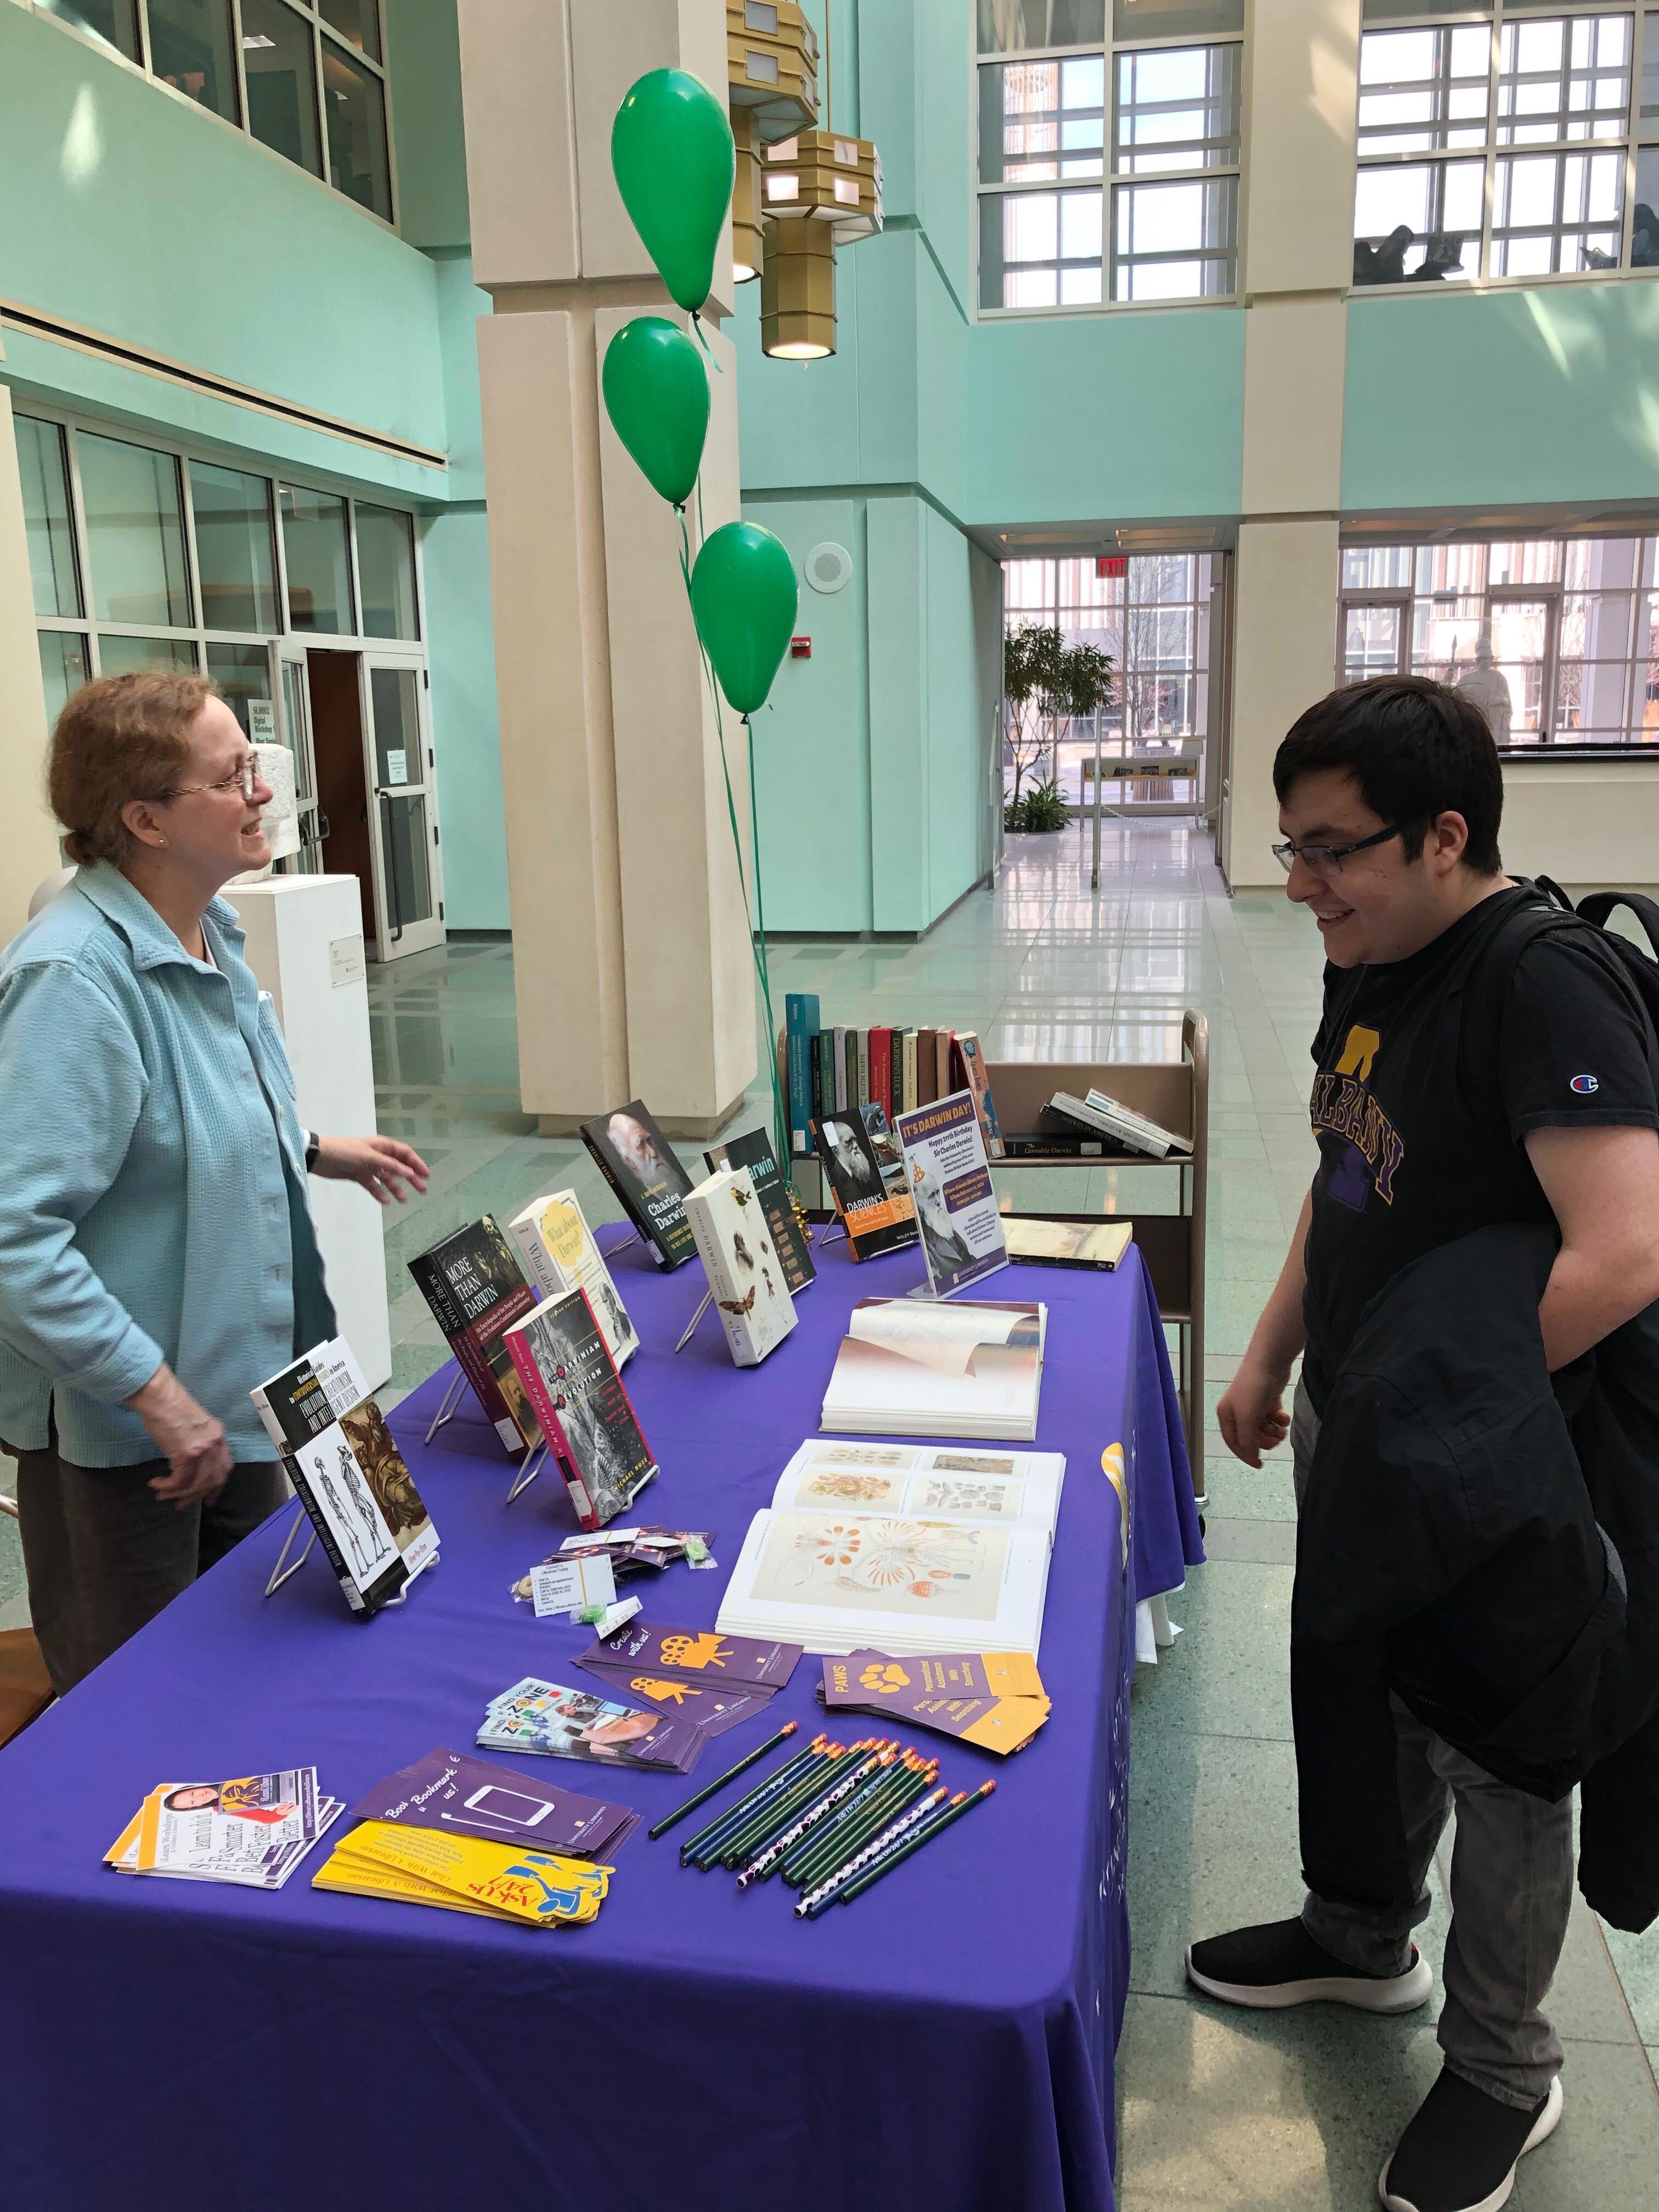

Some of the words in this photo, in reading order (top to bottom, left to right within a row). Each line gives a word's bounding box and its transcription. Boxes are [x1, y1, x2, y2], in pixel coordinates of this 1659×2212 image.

[1100, 558, 1126, 576] EXIT
[902, 1122, 918, 1139] IT'S
[918, 1108, 953, 1132] DARWIN
[952, 1102, 972, 1120] DAY!
[928, 1137, 943, 1148] Happy
[954, 1125, 973, 1137] Birthday
[940, 1143, 956, 1154] Charles
[956, 1136, 973, 1149] Darwin!
[749, 1156, 775, 1181] arwin
[647, 1192, 681, 1217] Charles
[847, 1193, 884, 1214] DARWIN'S
[851, 1204, 887, 1223] SCIENCES
[546, 1227, 564, 1243] What
[563, 1215, 578, 1234] about
[695, 1207, 706, 1233] CHARLES
[703, 1235, 718, 1267] DARWIN
[528, 1243, 545, 1273] What
[557, 1230, 582, 1259] Darwin?
[445, 1256, 473, 1284] MORE
[428, 1274, 447, 1302] MORE
[443, 1300, 461, 1328] THAN
[454, 1273, 482, 1301] THAN
[428, 1296, 451, 1332] DARWIN
[464, 1284, 499, 1319] DARWIN
[565, 1296, 580, 1308] EDITION
[550, 1374, 558, 1383] THE
[557, 1341, 601, 1380] DARWINIAN
[293, 1378, 320, 1401] CONTROVERSIAL
[332, 1361, 346, 1372] America
[297, 1368, 314, 1385] Historical
[557, 1368, 602, 1409] REVOLUTION
[308, 1415, 321, 1434] AND
[317, 1393, 346, 1426] INTELLIGENT
[342, 1385, 360, 1407] DESIGN
[523, 1365, 534, 1383] THE
[532, 1387, 559, 1444] DARWINIAN
[614, 1470, 634, 1491] MICHAEL
[634, 1457, 648, 1471] RUSE
[312, 1511, 320, 1523] AND
[317, 1520, 335, 1551] INTELLIGENT
[329, 1548, 341, 1567] DESIGN
[610, 1629, 633, 1651] Create
[628, 1640, 641, 1657] with
[639, 1628, 652, 1647] us!
[755, 1656, 772, 1680] UNIVERSITY
[769, 1643, 782, 1661] LIBRARIES
[833, 1664, 849, 1693] PAWS
[498, 1697, 515, 1709] FIND
[514, 1684, 535, 1697] YOUR
[697, 1705, 729, 1726] UNIVERSITY
[951, 1700, 982, 1722] Searching
[636, 1739, 658, 1756] UNIVERSITY
[657, 1725, 675, 1739] LIBRARIES
[410, 1768, 458, 1805] Bookmark
[443, 1782, 459, 1799] us!
[162, 1813, 175, 1843] Workshops
[219, 1822, 243, 1852] Smarter
[248, 1824, 271, 1848] Faster
[276, 1820, 299, 1843] Better
[567, 1822, 590, 1844] UNIVERSITY
[589, 1805, 606, 1825] LIBRARIES
[160, 1844, 170, 1862] iLearn
[189, 1833, 211, 1853] Learn
[359, 1845, 398, 1862] Librarian
[347, 1872, 390, 1884] Librarian
[408, 1861, 428, 1874] With
[431, 1871, 450, 1882] Chat
[404, 1882, 427, 1892] With
[488, 1876, 534, 1894] 24/7
